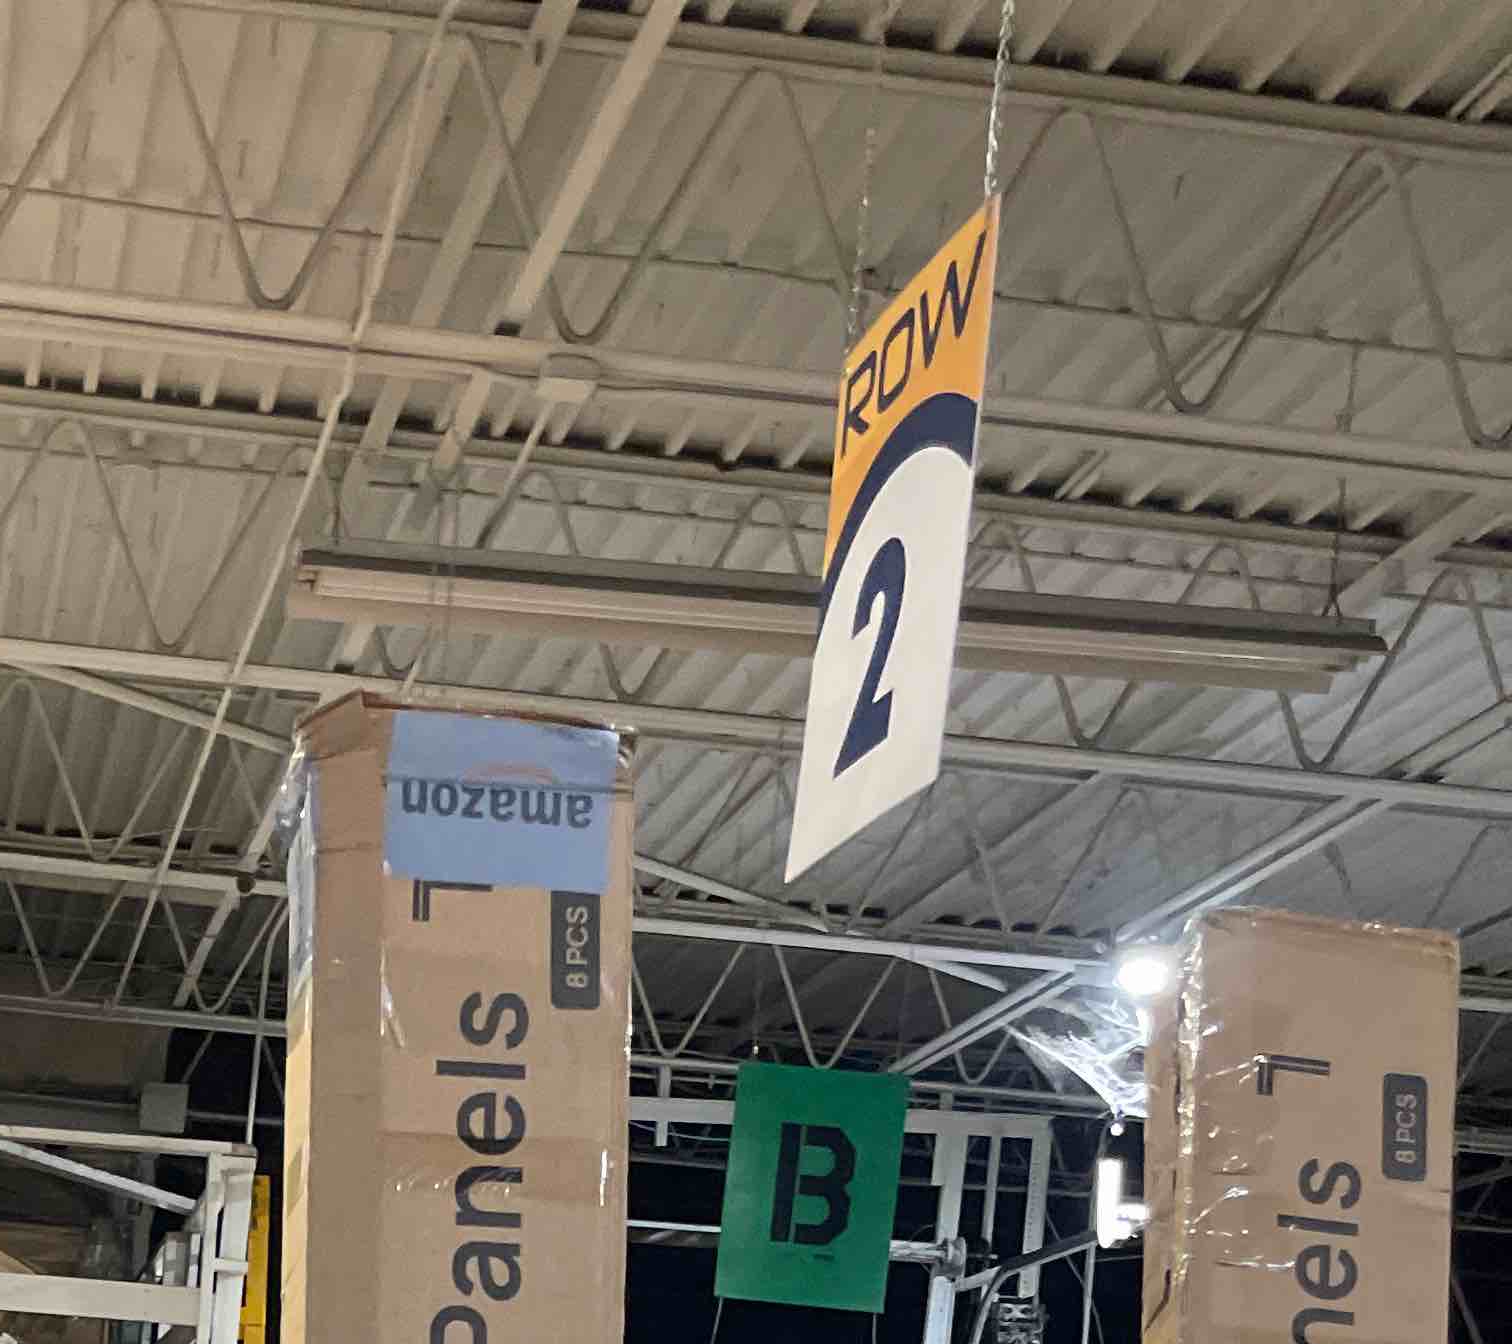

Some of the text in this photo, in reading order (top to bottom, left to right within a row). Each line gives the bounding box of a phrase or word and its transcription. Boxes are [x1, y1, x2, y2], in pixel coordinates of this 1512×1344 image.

[840, 230, 988, 458] ROW
[832, 536, 907, 779] 2
[400, 777, 594, 829] amazon
[565, 905, 589, 989] 8 PCS
[1394, 1092, 1419, 1165] 8 PCS
[770, 1121, 857, 1246] B
